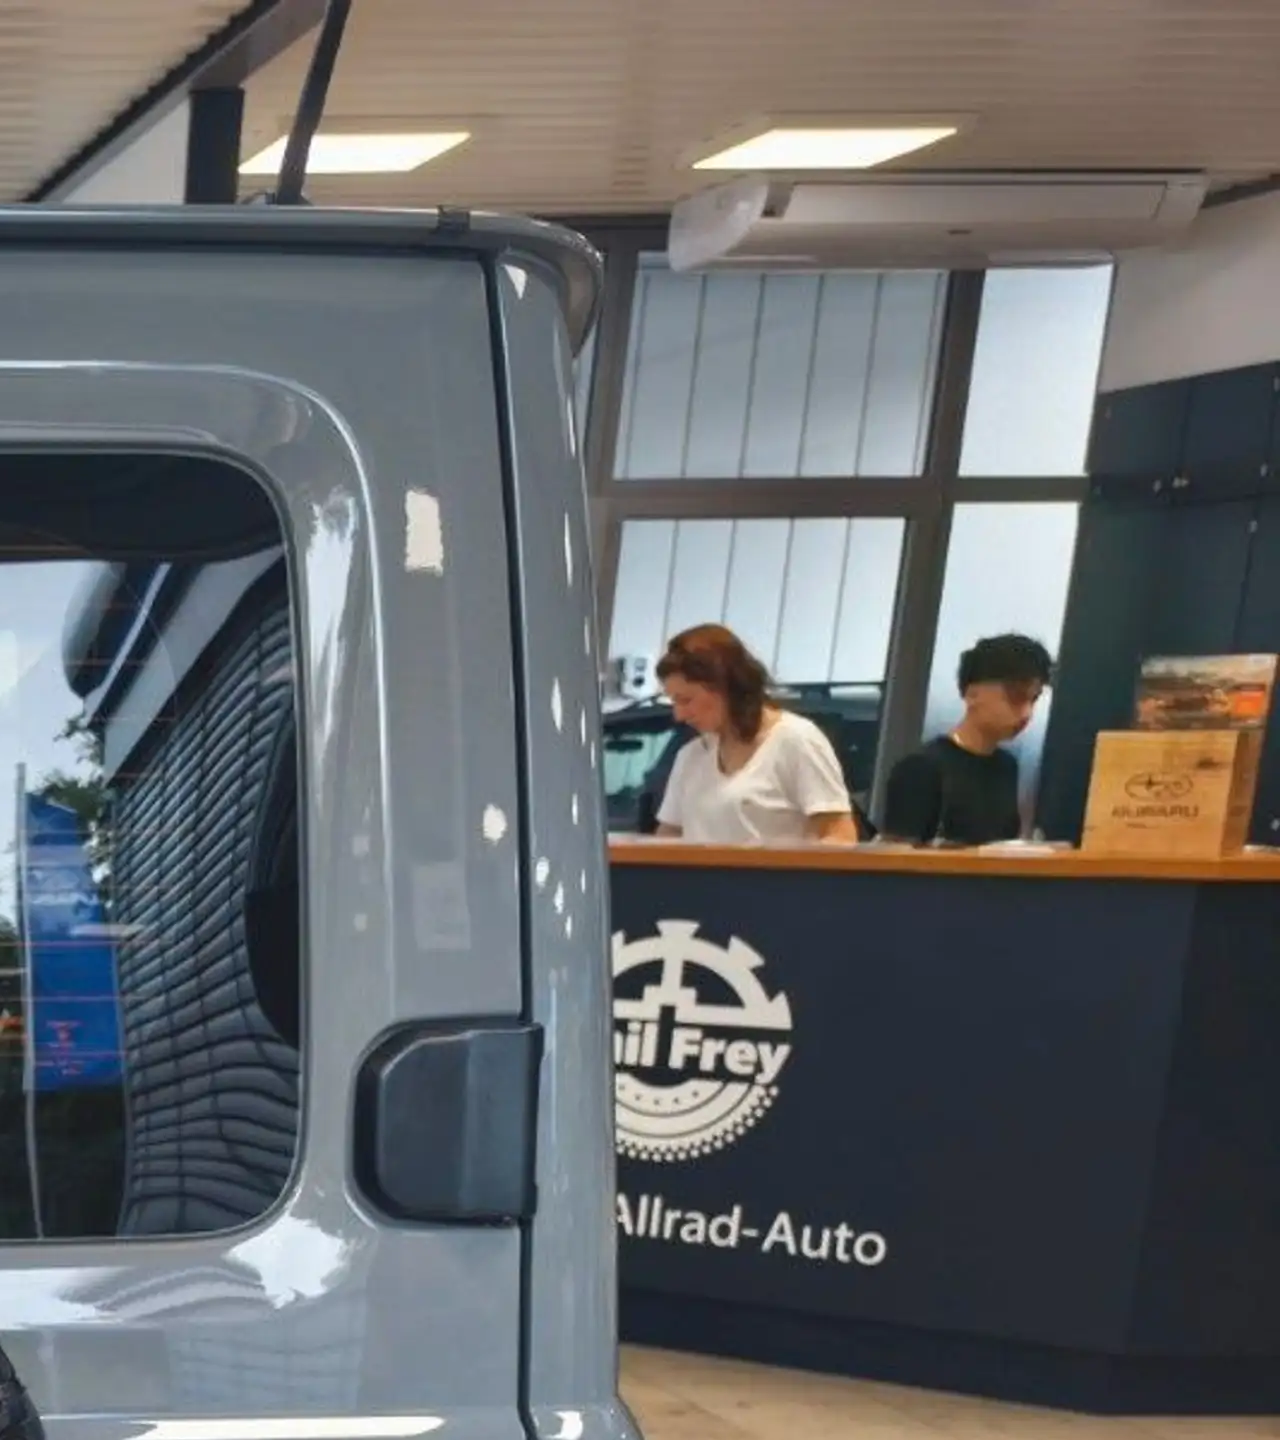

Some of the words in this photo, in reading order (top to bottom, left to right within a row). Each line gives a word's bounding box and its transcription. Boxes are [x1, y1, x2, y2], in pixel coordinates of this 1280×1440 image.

[614, 1019, 660, 1068] il
[668, 1027, 793, 1084] Frey
[615, 1192, 888, 1266] Allrad-Auto
